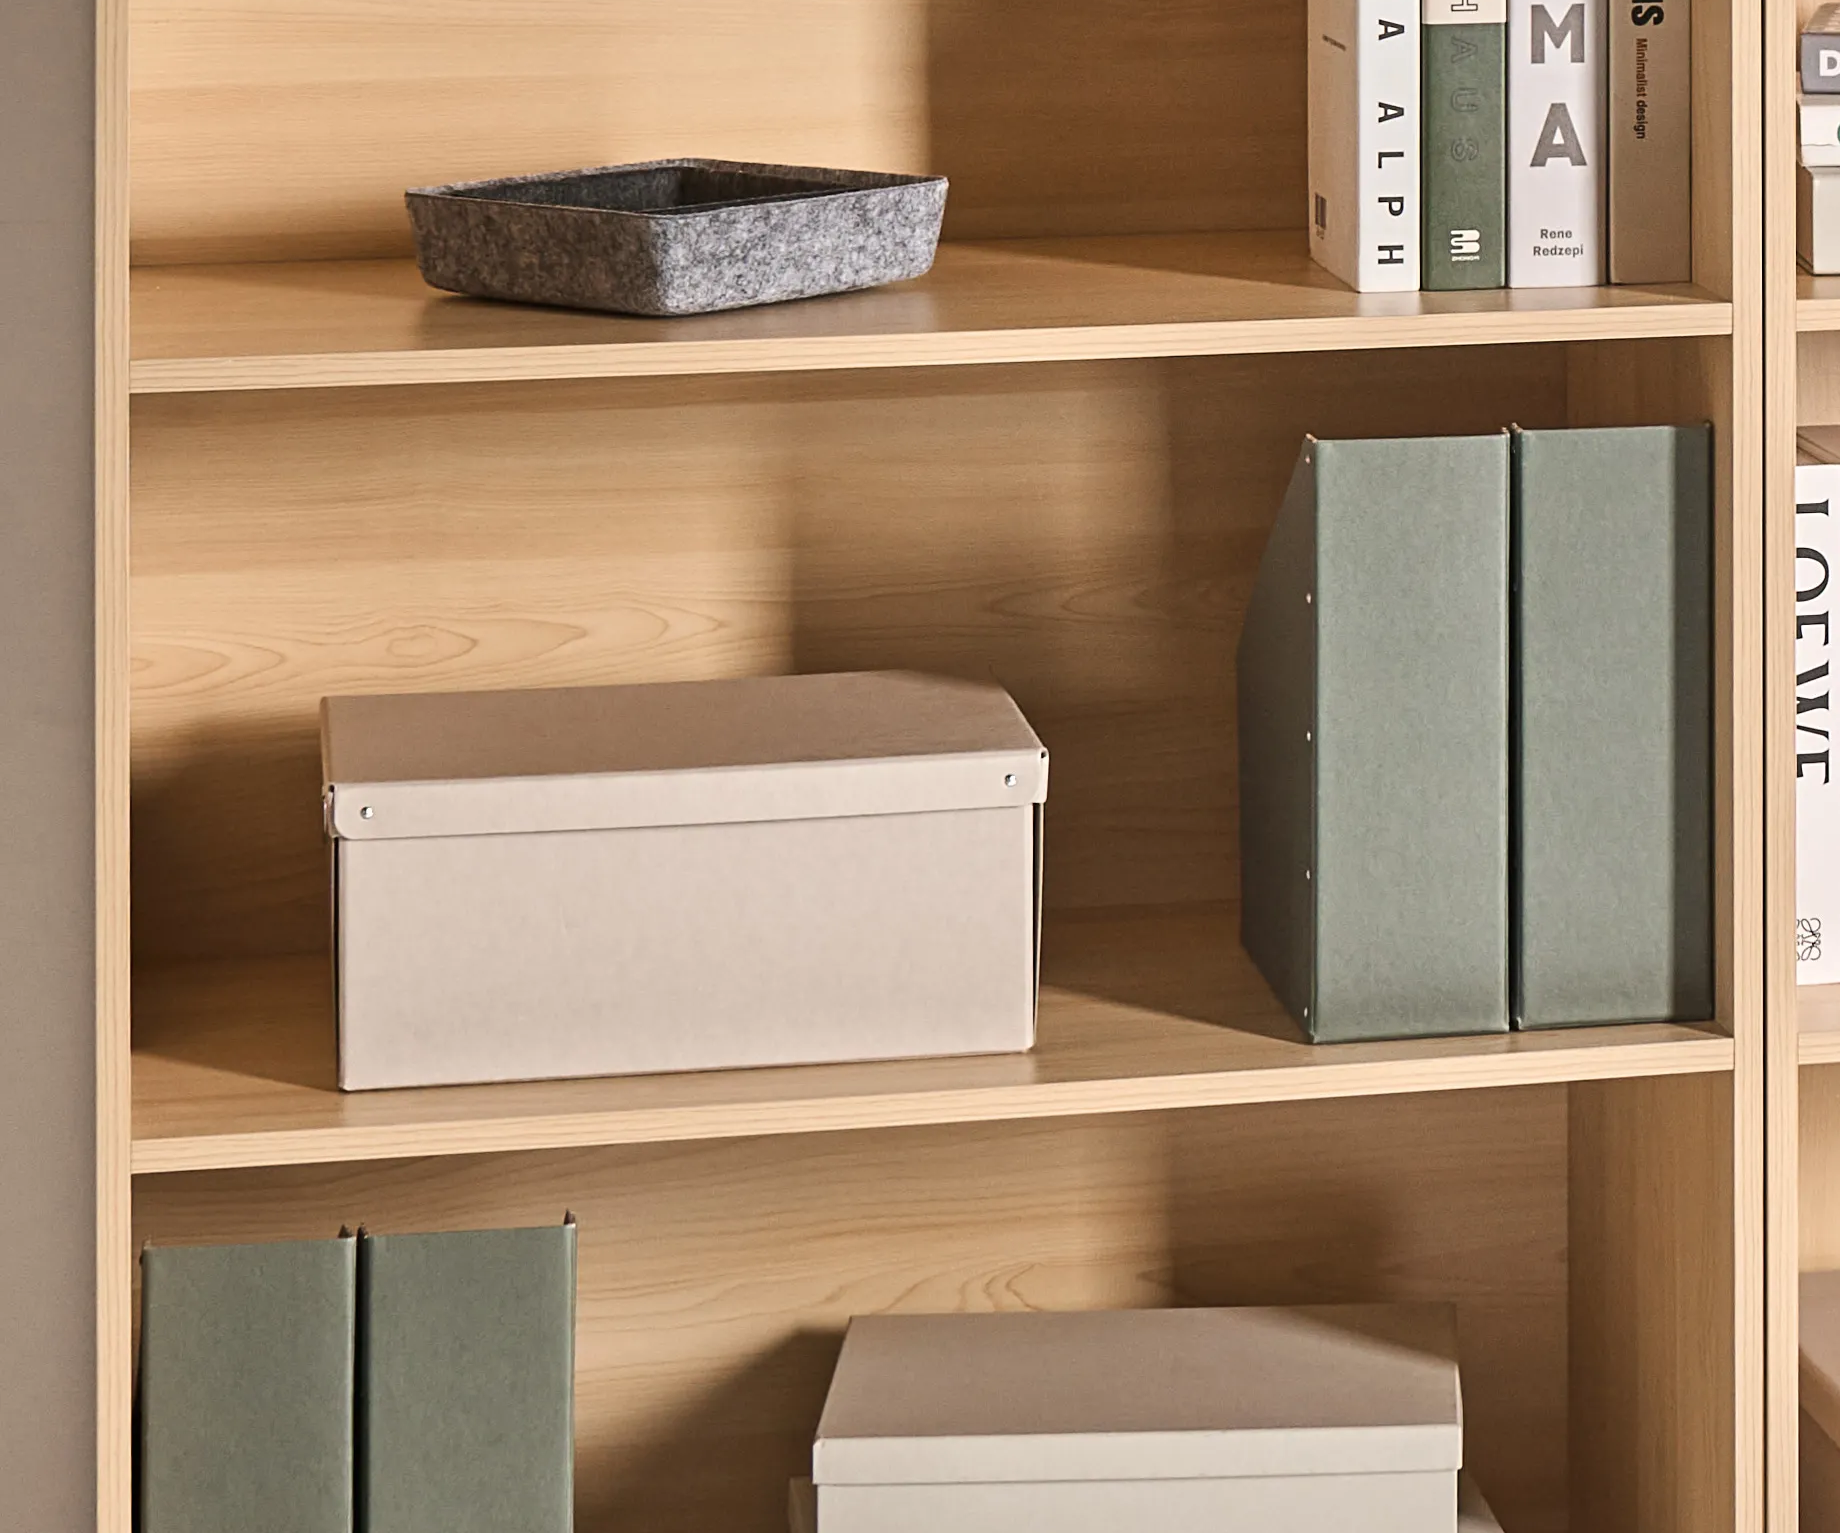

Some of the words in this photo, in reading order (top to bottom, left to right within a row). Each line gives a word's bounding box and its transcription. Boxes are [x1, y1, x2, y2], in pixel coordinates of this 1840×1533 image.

[1636, 39, 1647, 97] Minimalist
[1634, 100, 1648, 139] design
[1378, 102, 1404, 264] ALPH
[1534, 245, 1583, 257] Redzepi
[1541, 229, 1572, 238] Rene
